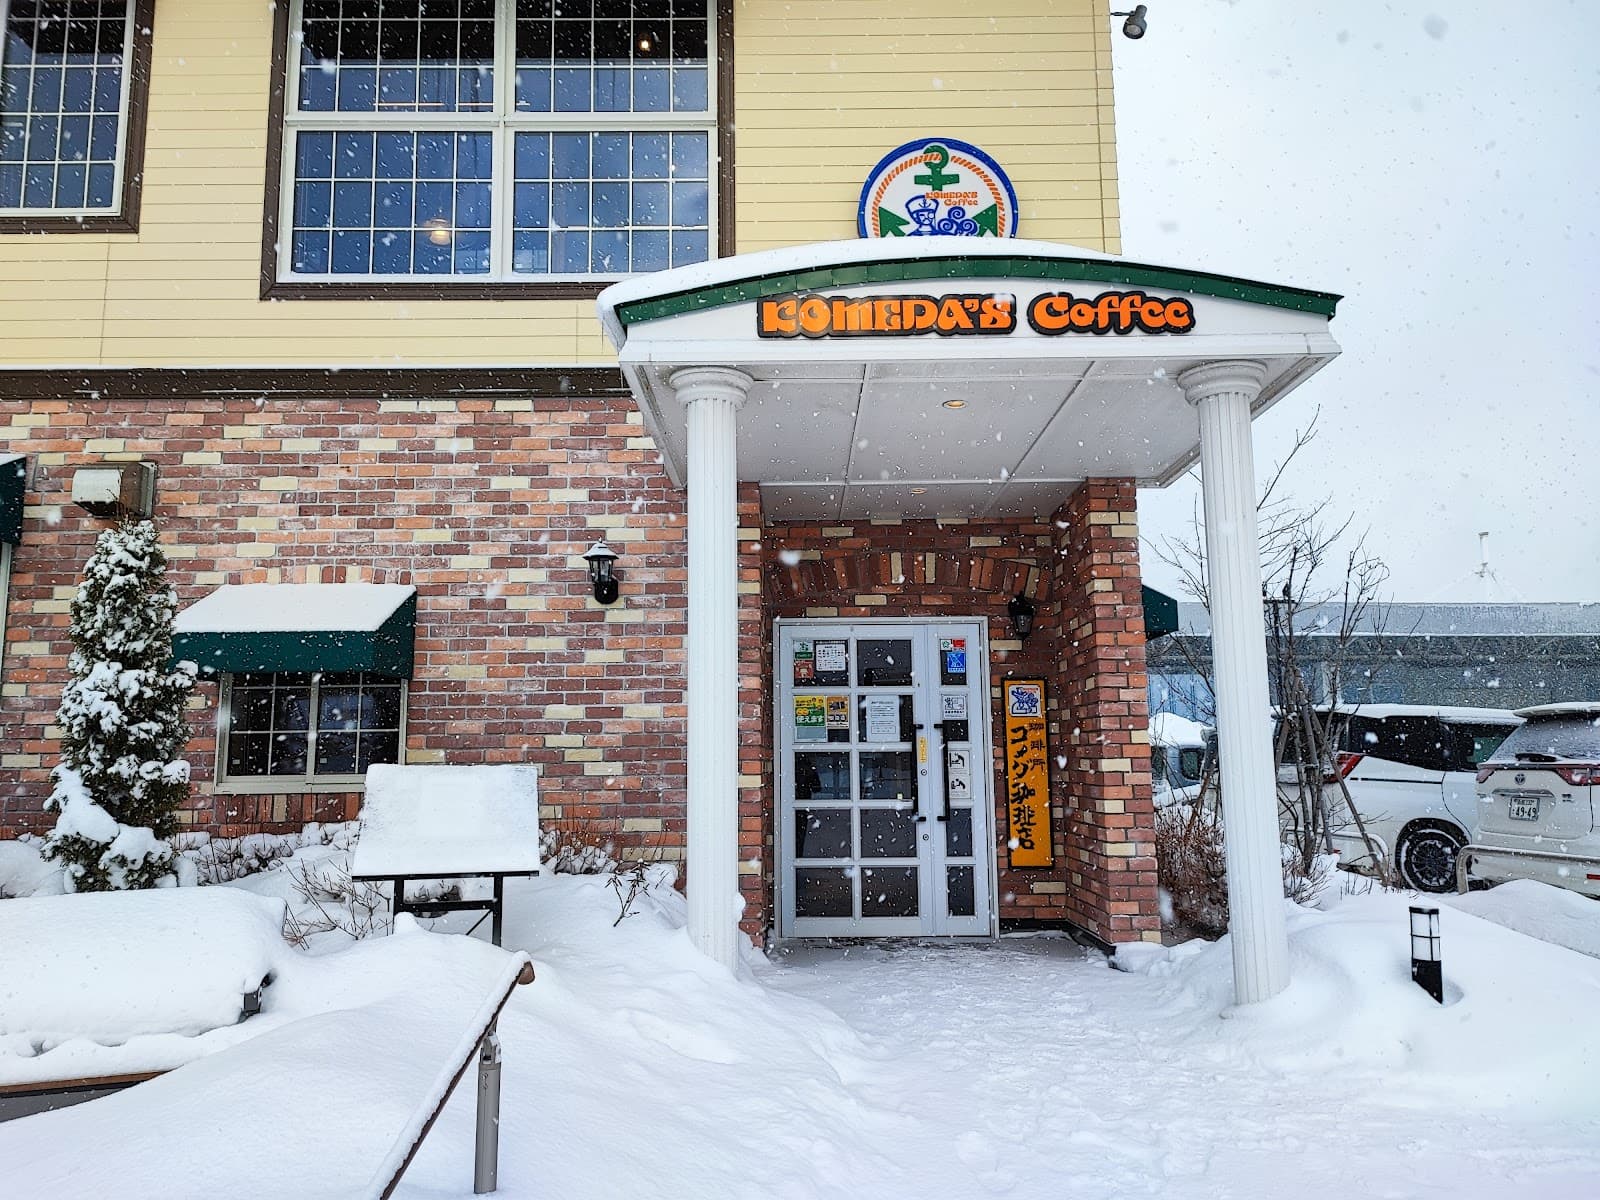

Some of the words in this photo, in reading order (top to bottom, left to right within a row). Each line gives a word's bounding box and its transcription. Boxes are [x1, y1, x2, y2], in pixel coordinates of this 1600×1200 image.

[925, 191, 978, 199] KOMEDA'S
[760, 296, 1014, 336] KOMEDA'S
[1030, 293, 1194, 333] Coffee
